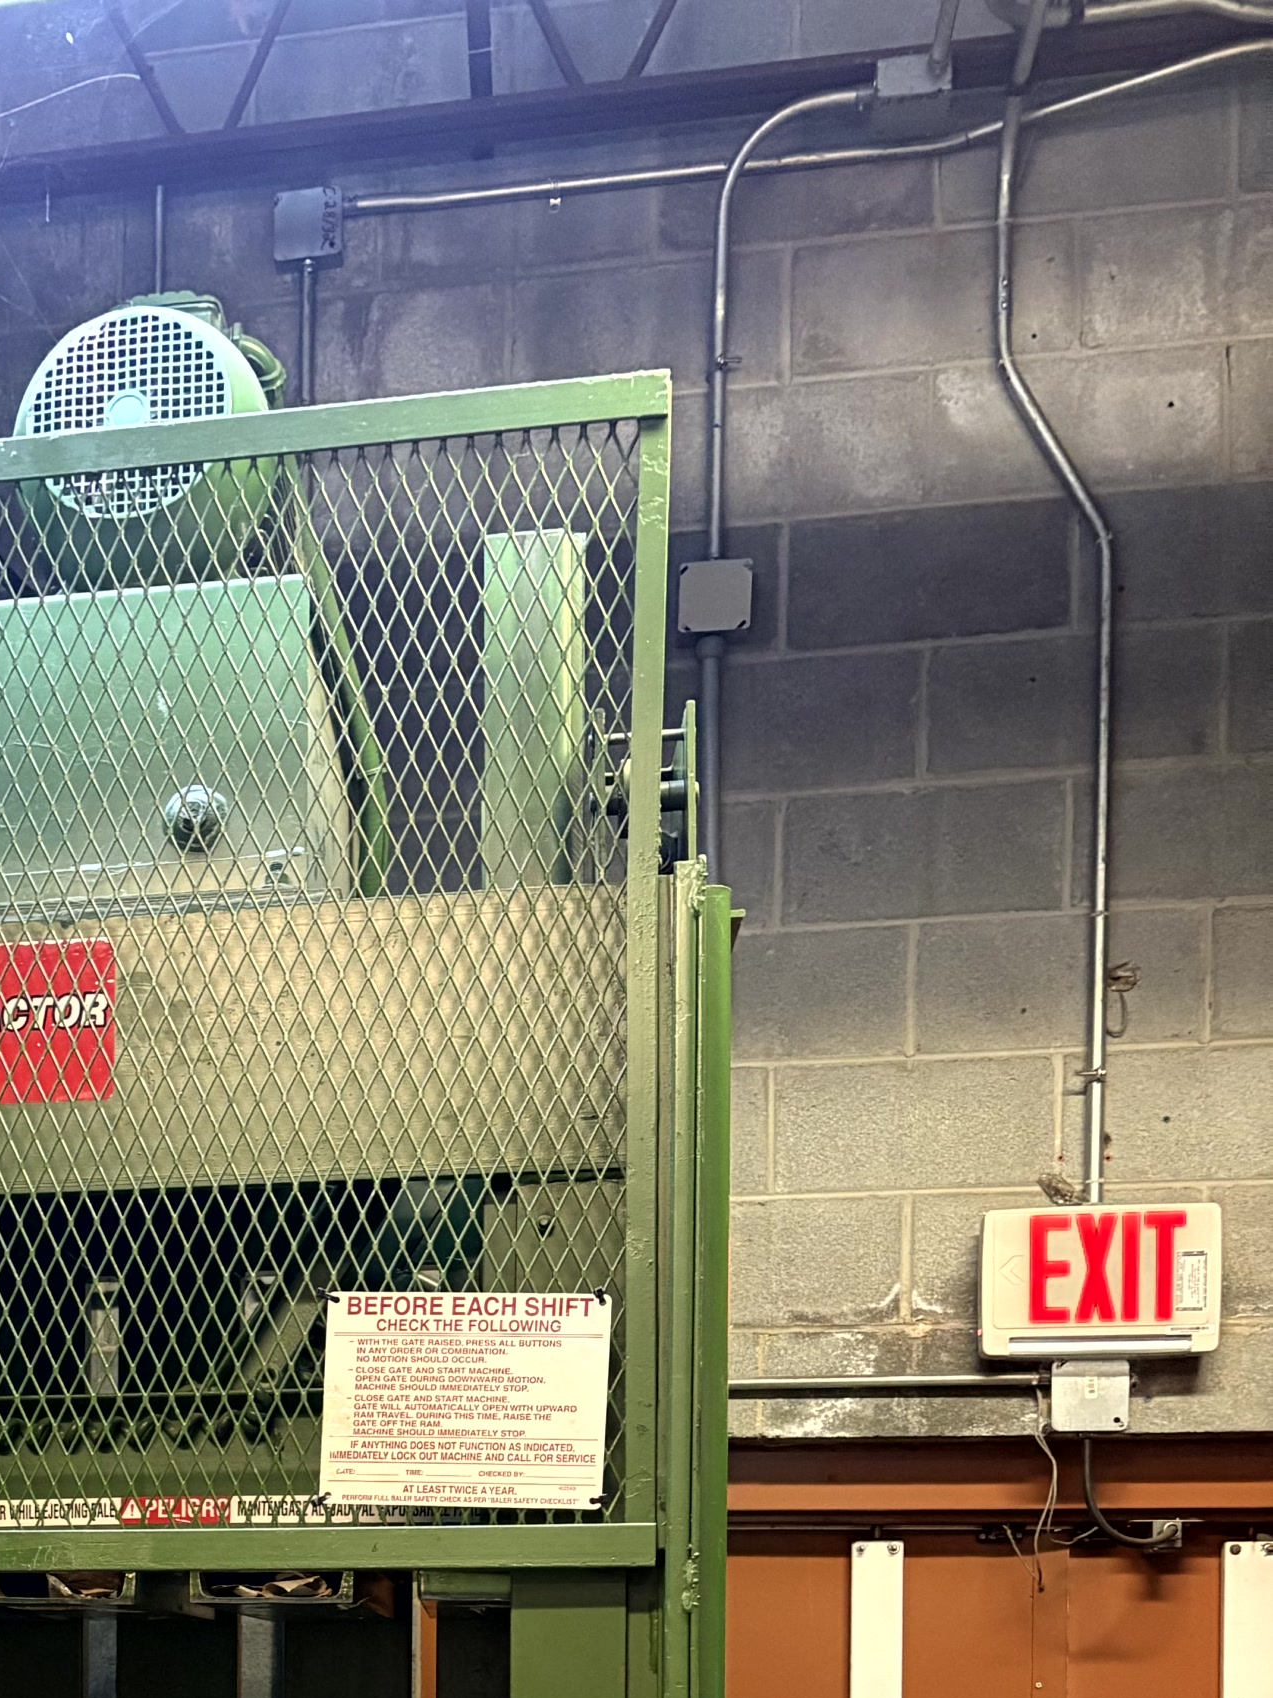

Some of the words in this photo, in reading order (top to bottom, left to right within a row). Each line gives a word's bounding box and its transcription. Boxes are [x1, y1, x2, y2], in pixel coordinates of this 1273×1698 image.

[1029, 1211, 1187, 1324] EXIT
[347, 1296, 443, 1316] BEFORE
[452, 1296, 516, 1316] EACH
[525, 1298, 594, 1317] SHIFT
[376, 1319, 430, 1331] CHECK
[434, 1319, 463, 1332] THE
[468, 1320, 562, 1332] FOLLOWING
[350, 1440, 357, 1448] IF
[361, 1440, 407, 1450] ANYTHING
[410, 1441, 435, 1450] DOES
[438, 1442, 456, 1450] NOT
[459, 1442, 506, 1451] FUNCTION
[509, 1443, 521, 1451] AS
[403, 1485, 414, 1493] AT
[417, 1485, 447, 1494] LEAST
[449, 1486, 478, 1494] TWICE
[489, 1486, 517, 1495] YEAR.
[146, 1498, 228, 1518] PELIGRO
